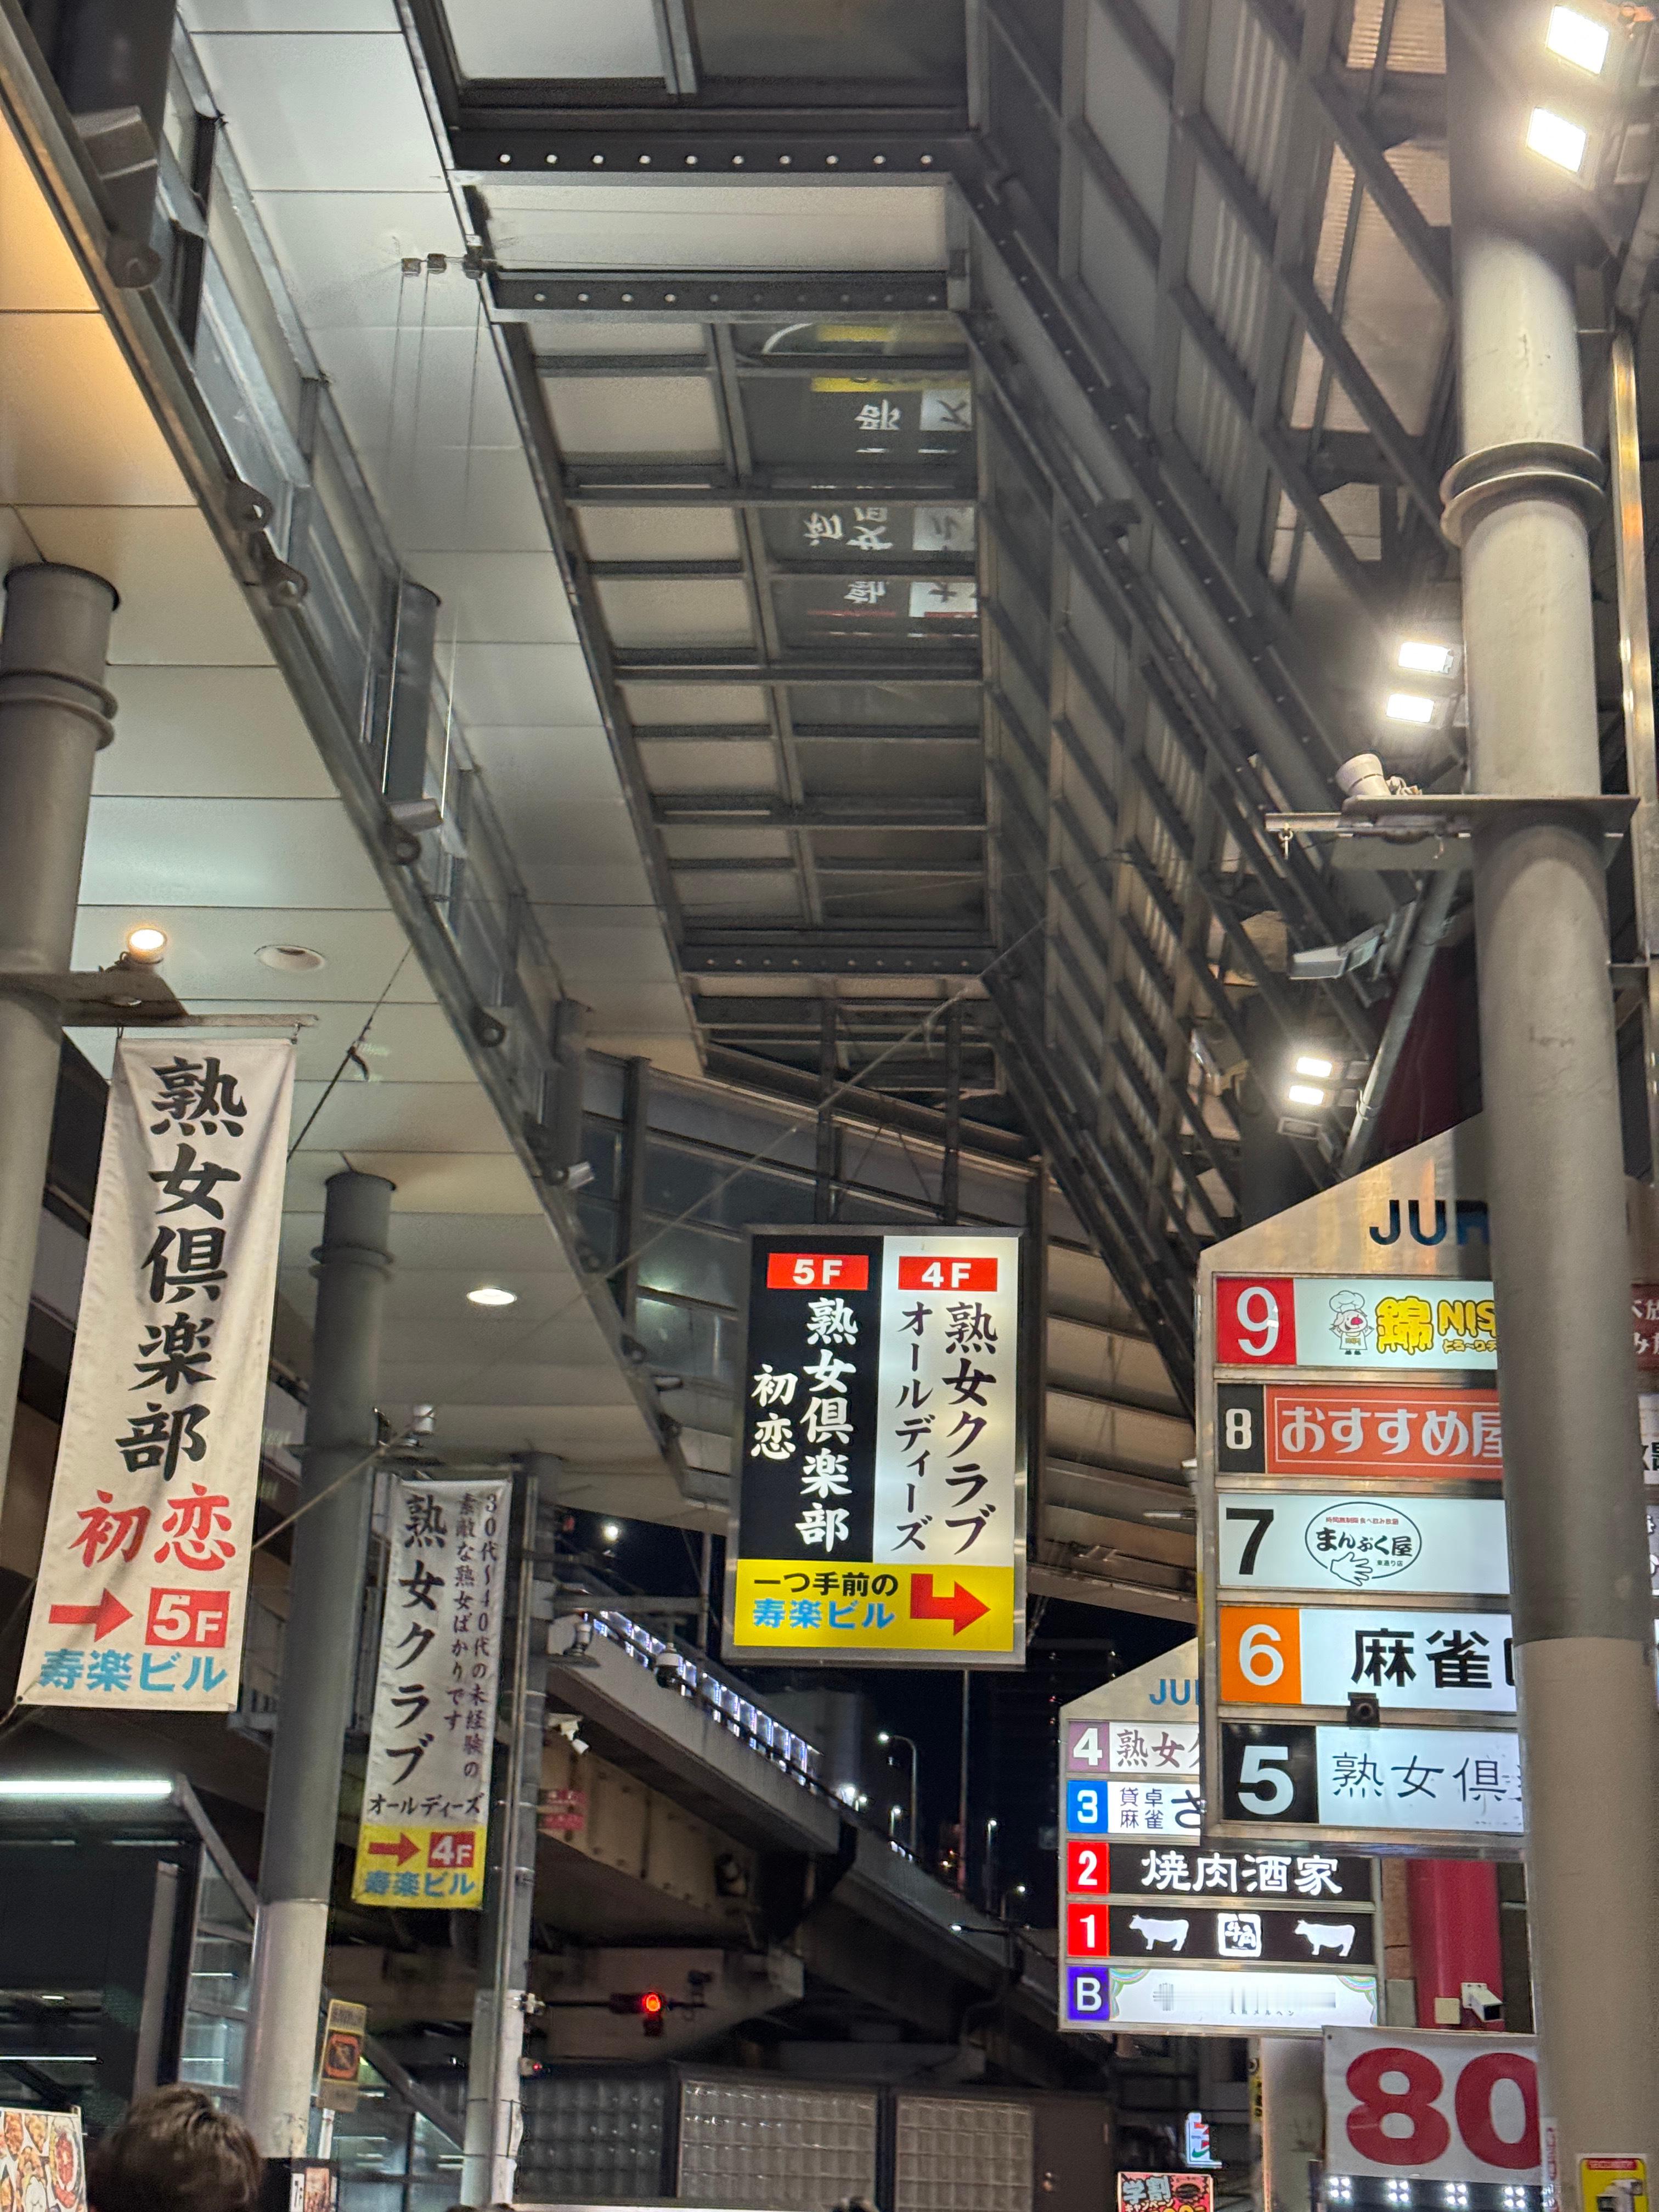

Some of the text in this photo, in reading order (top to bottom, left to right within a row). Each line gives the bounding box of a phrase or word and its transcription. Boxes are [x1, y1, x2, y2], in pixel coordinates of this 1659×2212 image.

[115, 1057, 247, 1481] 熟女倶楽部
[792, 1258, 843, 1285] 5F
[921, 1261, 972, 1289] 4F
[1237, 1285, 1280, 1358] 9
[1375, 1295, 1434, 1356] 錦
[751, 1364, 798, 1461] 初恋
[795, 1297, 859, 1553] 熟女倶楽部
[890, 1301, 934, 1551] オールディーズ
[941, 1301, 998, 1555] 熟女クラブ
[1225, 1408, 1252, 1450] 8
[67, 1481, 236, 1570] 初恋
[1225, 1507, 1276, 1575] 7
[753, 1571, 899, 1596] 一つ手前の
[153, 1593, 224, 1642] 5F
[752, 1597, 895, 1629] 寿楽ビル
[386, 1494, 447, 1786] 熟女クラブ
[1238, 1624, 1285, 1686] 6
[1351, 1628, 1516, 1689] 麻雀
[37, 1648, 227, 1694] 寿楽ビル
[1149, 1678, 1199, 1706] JU
[1072, 1727, 1103, 1765] 4
[1237, 1745, 1295, 1816] 5
[1331, 1752, 1522, 1803] 熟女倶
[369, 1795, 485, 1815] オールディーズ
[1076, 1790, 1099, 1824] 3
[1119, 1810, 1164, 1830] 麻雀
[431, 1836, 473, 1866] 4F
[1077, 1856, 1099, 1887] 2
[1142, 1849, 1344, 1896] 焼肉酒家
[365, 1871, 475, 1898] 寿楽ビル
[1080, 1915, 1097, 1948] 1
[1075, 1977, 1103, 2012] B
